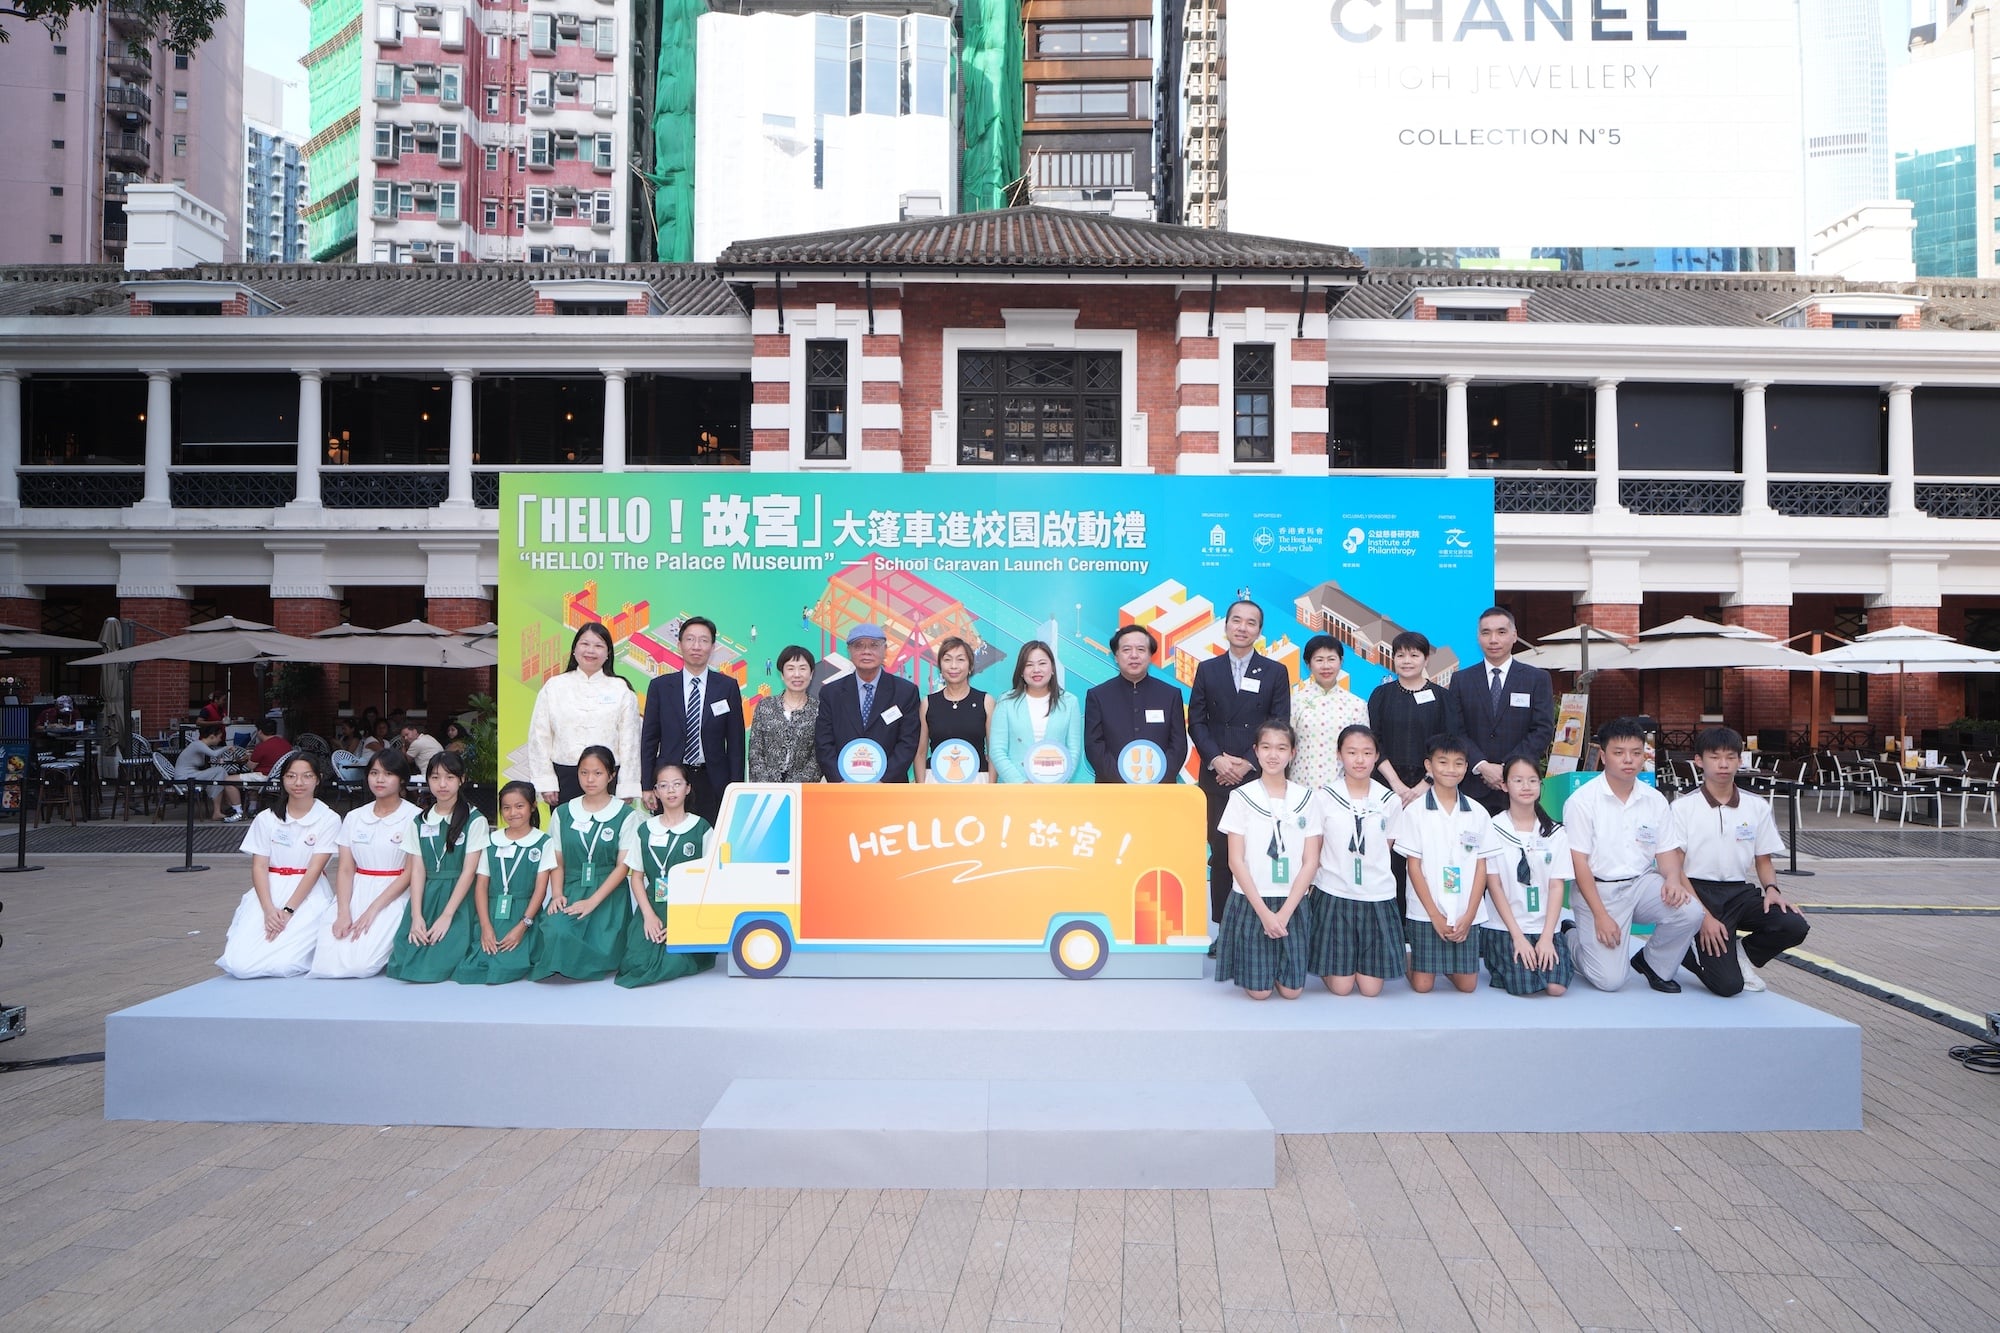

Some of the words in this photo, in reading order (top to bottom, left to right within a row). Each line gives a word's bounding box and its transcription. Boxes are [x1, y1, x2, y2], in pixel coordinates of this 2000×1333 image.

[1330, 0, 1687, 43] CHANEL
[1358, 65, 1451, 89] HIGH
[1471, 64, 1660, 94] JEWELLERY
[1398, 128, 1569, 146] COLLECTION
[1578, 128, 1622, 146] N°5
[833, 510, 1147, 548] 大篷車進校園啟動禮
[1279, 527, 1323, 535] 香港賽馬會
[1368, 530, 1420, 538] 公益慈善研究院
[1291, 536, 1306, 545] Hong
[1307, 536, 1323, 545] Kong
[1368, 538, 1400, 546] Institute
[1402, 538, 1411, 546] of
[1279, 544, 1299, 553] Jockey
[1299, 544, 1313, 552] Club
[1367, 546, 1416, 556] Philanthropy
[612, 552, 647, 569] The
[655, 552, 725, 569] Palace
[873, 555, 930, 570] School
[934, 556, 999, 571] Caravan
[1005, 556, 1063, 572] Launch
[1068, 557, 1149, 575] Ceremony
